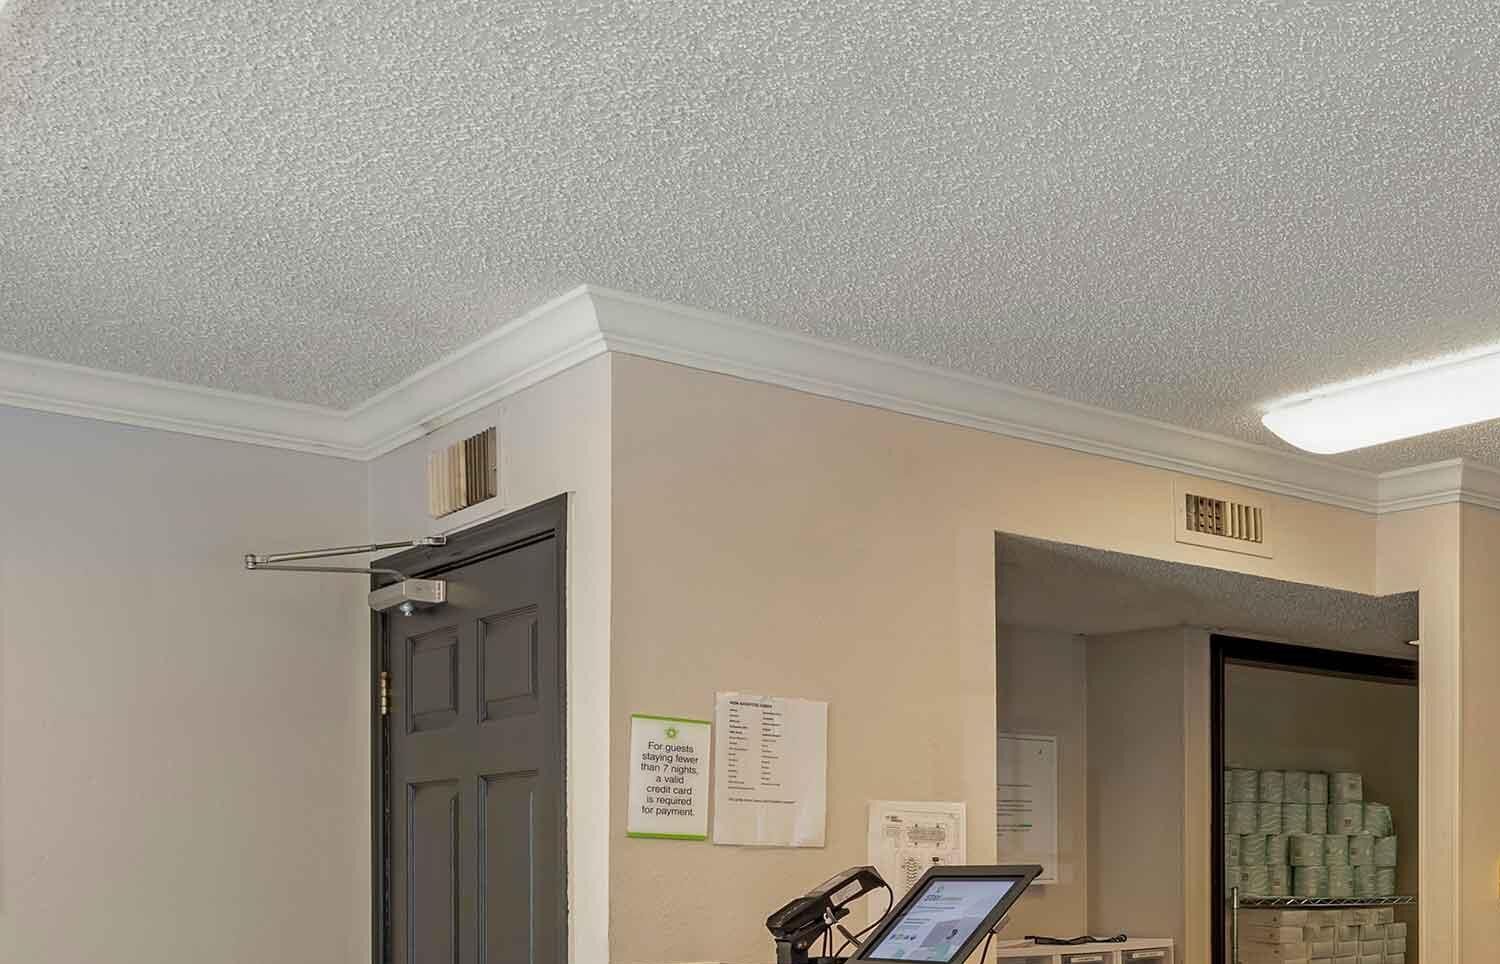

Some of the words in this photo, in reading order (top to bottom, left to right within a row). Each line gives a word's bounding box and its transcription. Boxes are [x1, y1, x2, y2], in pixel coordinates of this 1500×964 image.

[648, 741, 663, 751] For
[665, 744, 694, 754] guests
[642, 753, 673, 764] staying
[675, 754, 698, 764] fewer
[641, 763, 660, 772] than
[663, 764, 669, 773] 7
[671, 765, 699, 775] nights,
[664, 775, 684, 784] valid
[646, 785, 671, 794] credit
[673, 786, 692, 795] card
[656, 797, 692, 806] required
[641, 806, 653, 814] for
[656, 807, 695, 816] payment.
